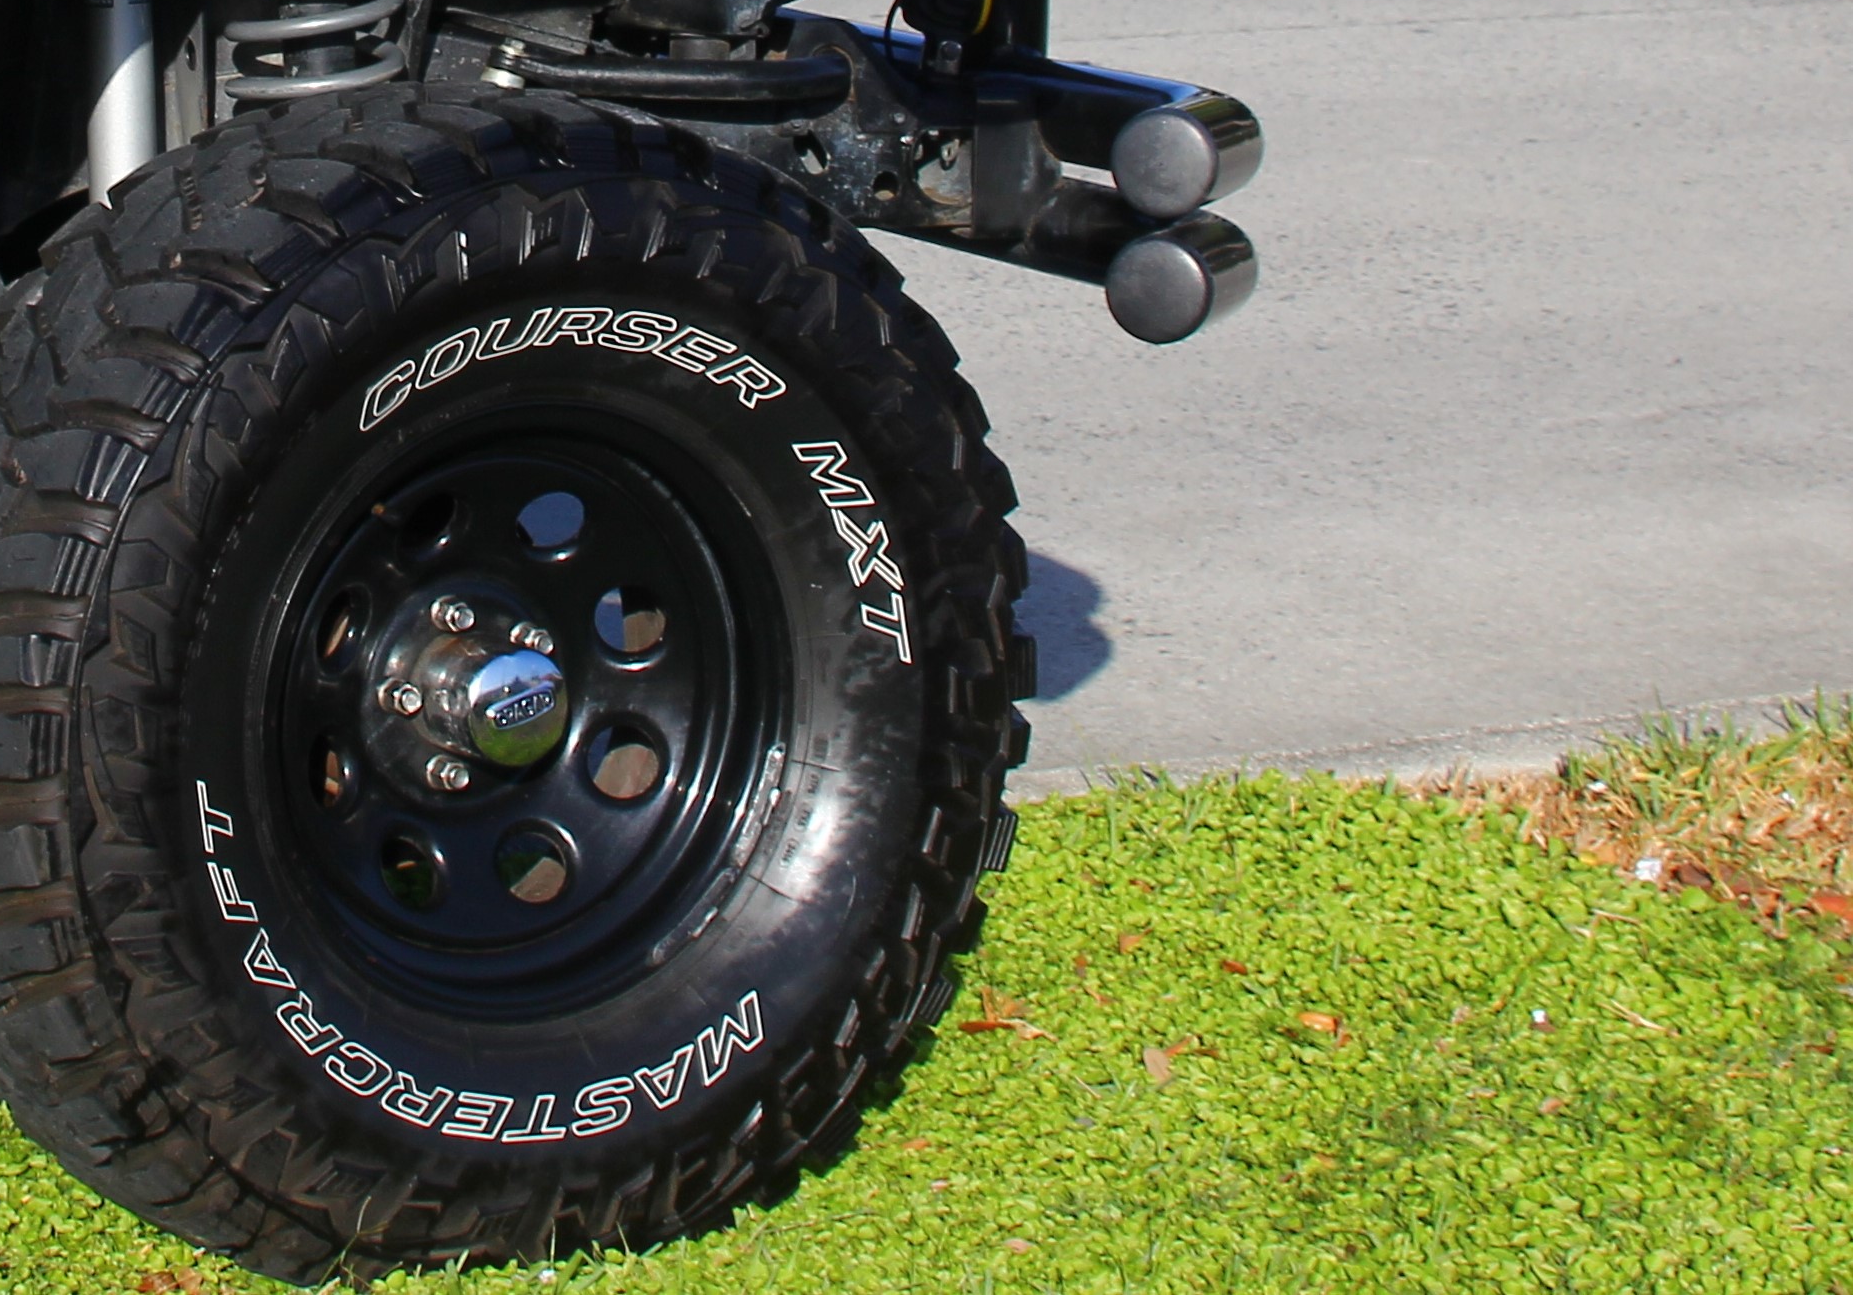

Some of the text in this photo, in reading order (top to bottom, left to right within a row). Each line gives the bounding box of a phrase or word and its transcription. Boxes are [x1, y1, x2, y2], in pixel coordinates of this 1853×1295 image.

[358, 306, 787, 432] COURSER
[792, 440, 913, 664] MXT
[196, 780, 765, 1144] MASTERCRAFT
